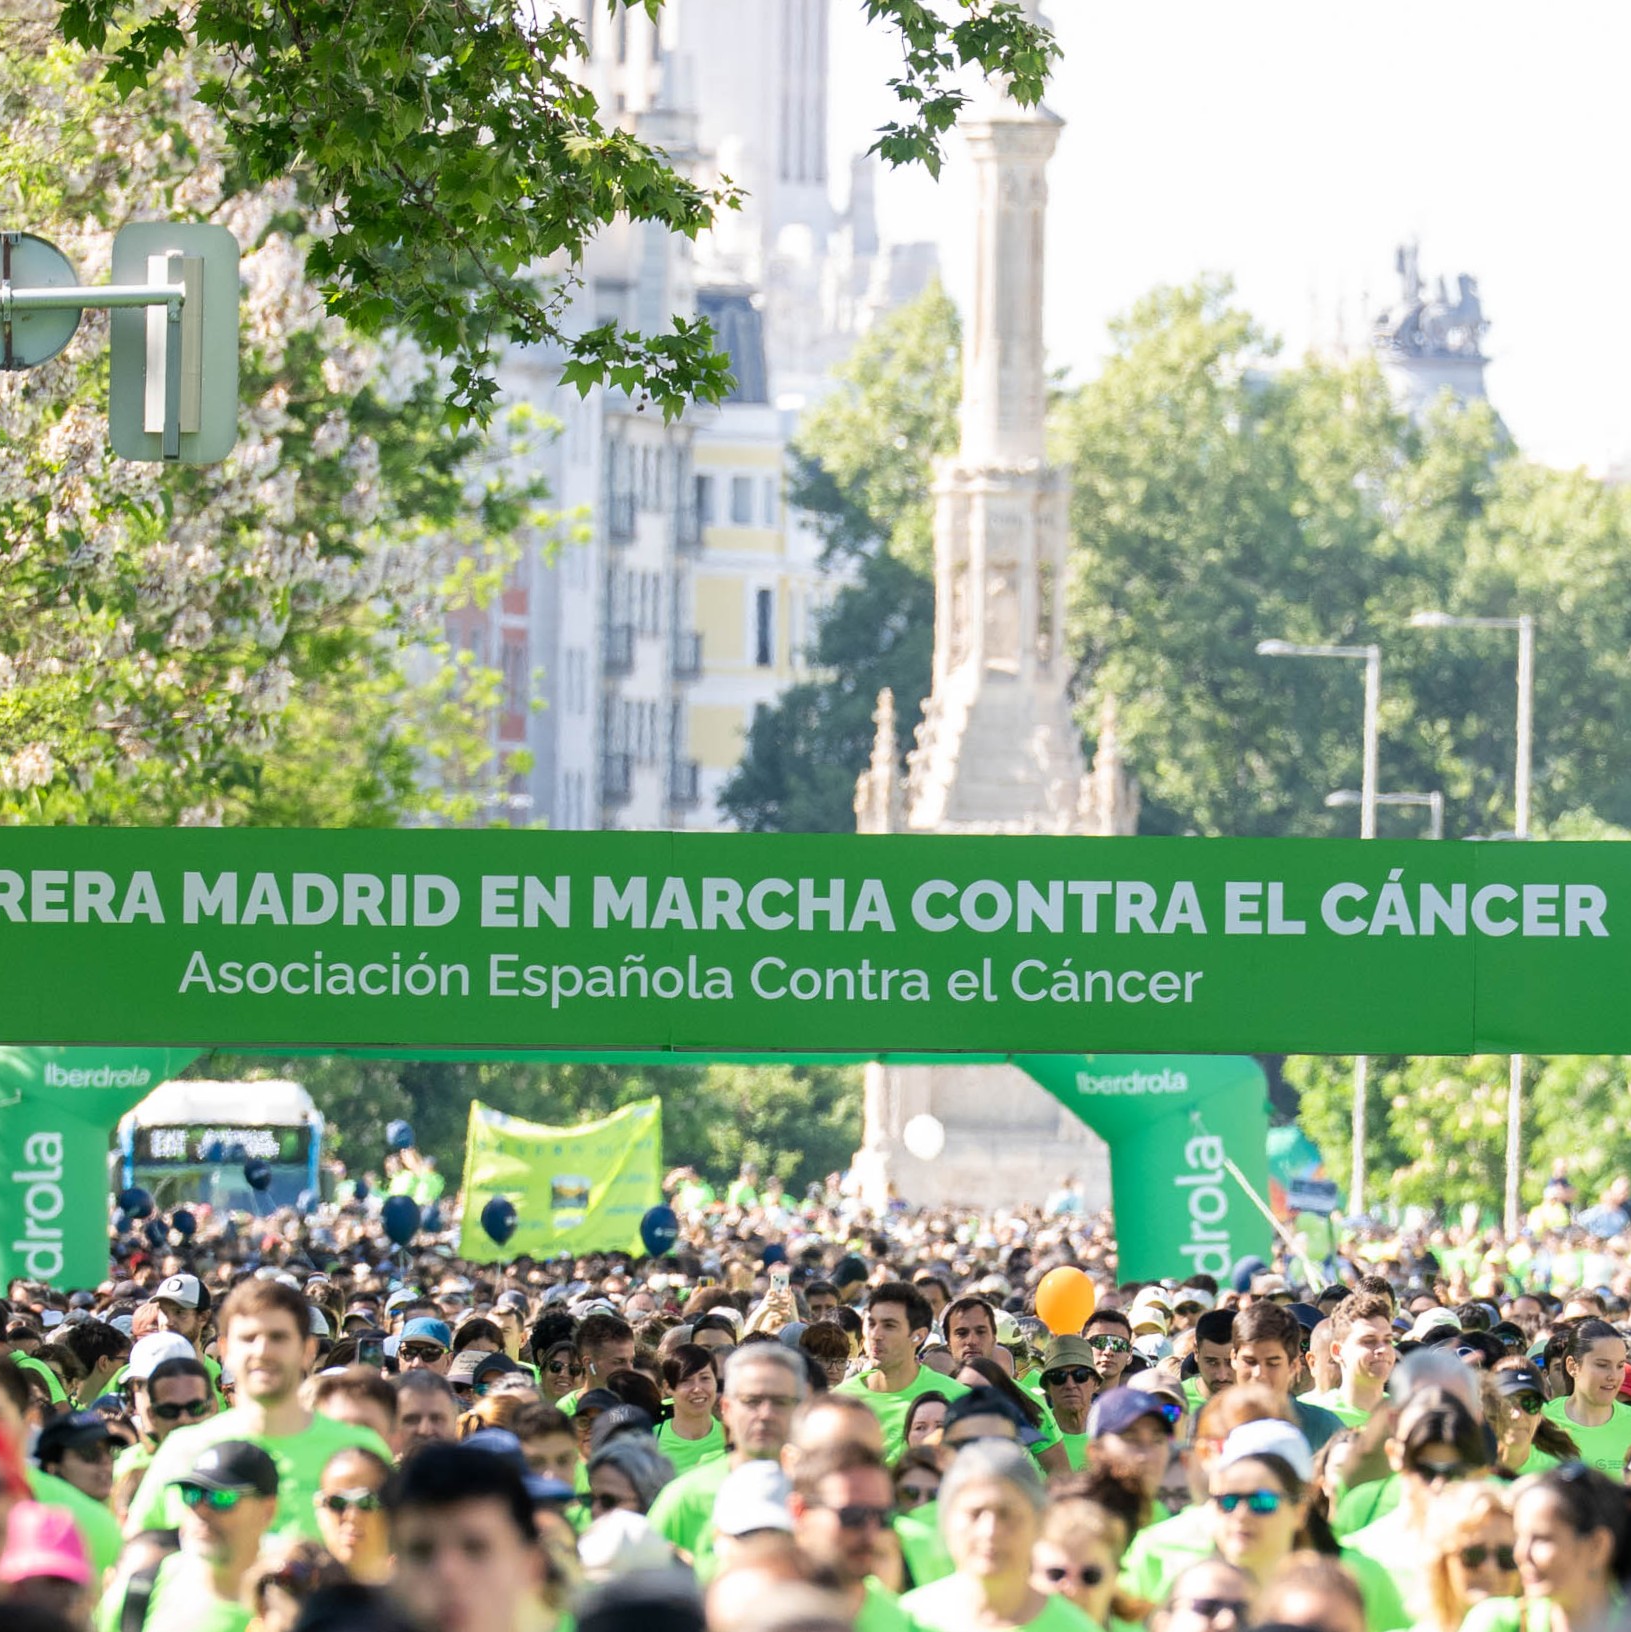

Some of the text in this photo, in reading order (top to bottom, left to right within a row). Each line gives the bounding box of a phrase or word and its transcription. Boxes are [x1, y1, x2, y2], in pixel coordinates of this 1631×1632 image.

[183, 872, 460, 926] MADRID
[481, 876, 570, 927] EN
[593, 876, 896, 931] MARCHA
[912, 880, 1207, 933] CONTRA
[1225, 882, 1305, 934] EL
[1321, 869, 1609, 936] CÁNCER
[179, 951, 1203, 1008] Asociación Española Contra el Cáncer
[44, 1062, 151, 1087] Iberdrola
[1076, 1068, 1188, 1095] Iberdrola
[11, 1132, 64, 1283] drola
